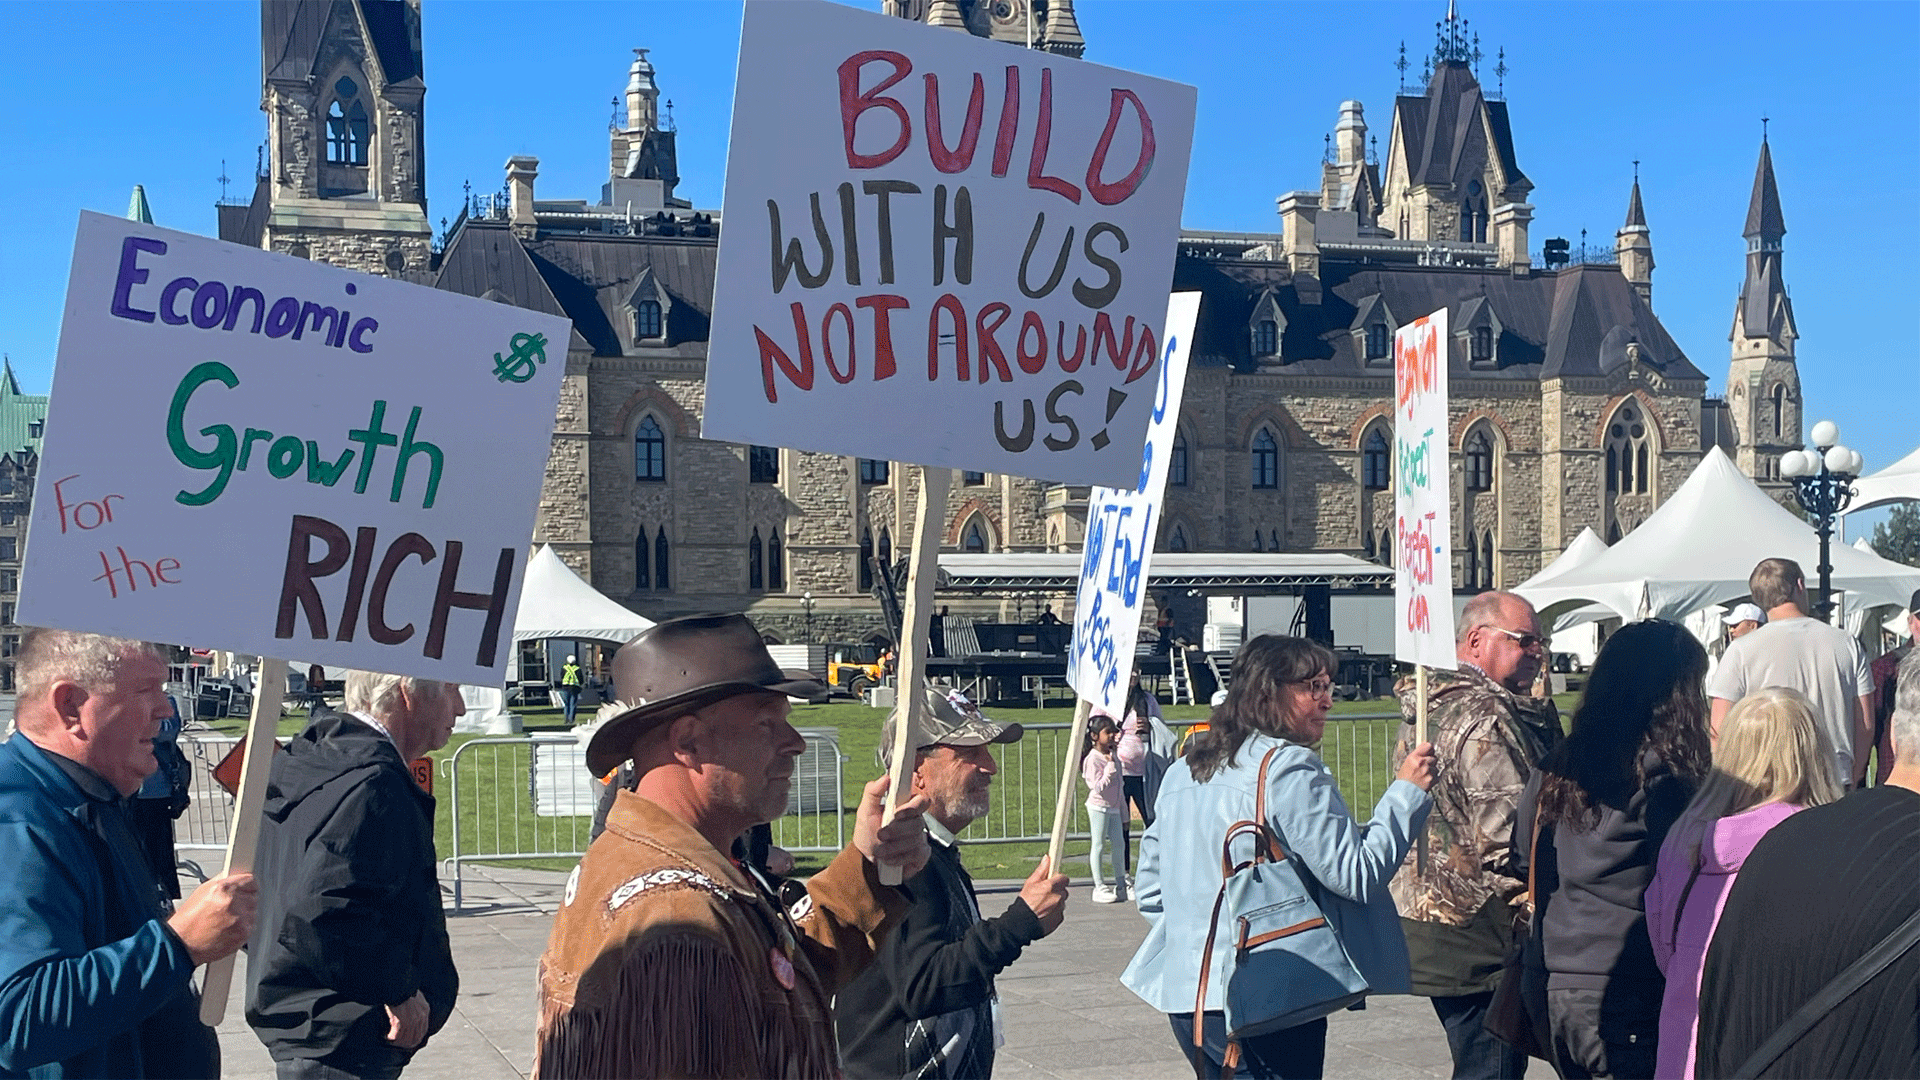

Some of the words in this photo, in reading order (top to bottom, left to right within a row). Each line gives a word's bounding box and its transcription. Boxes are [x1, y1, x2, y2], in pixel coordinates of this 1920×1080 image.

[837, 50, 1156, 206] BUILD
[111, 237, 379, 353] Economic
[767, 180, 973, 294] WITH
[1018, 212, 1129, 309] US
[753, 294, 910, 403] NOT
[927, 293, 1157, 384] AROUND
[167, 361, 444, 508] Growth
[994, 379, 1128, 453] US!
[54, 474, 125, 534] For
[92, 546, 182, 598] the
[275, 514, 515, 668] RICH
